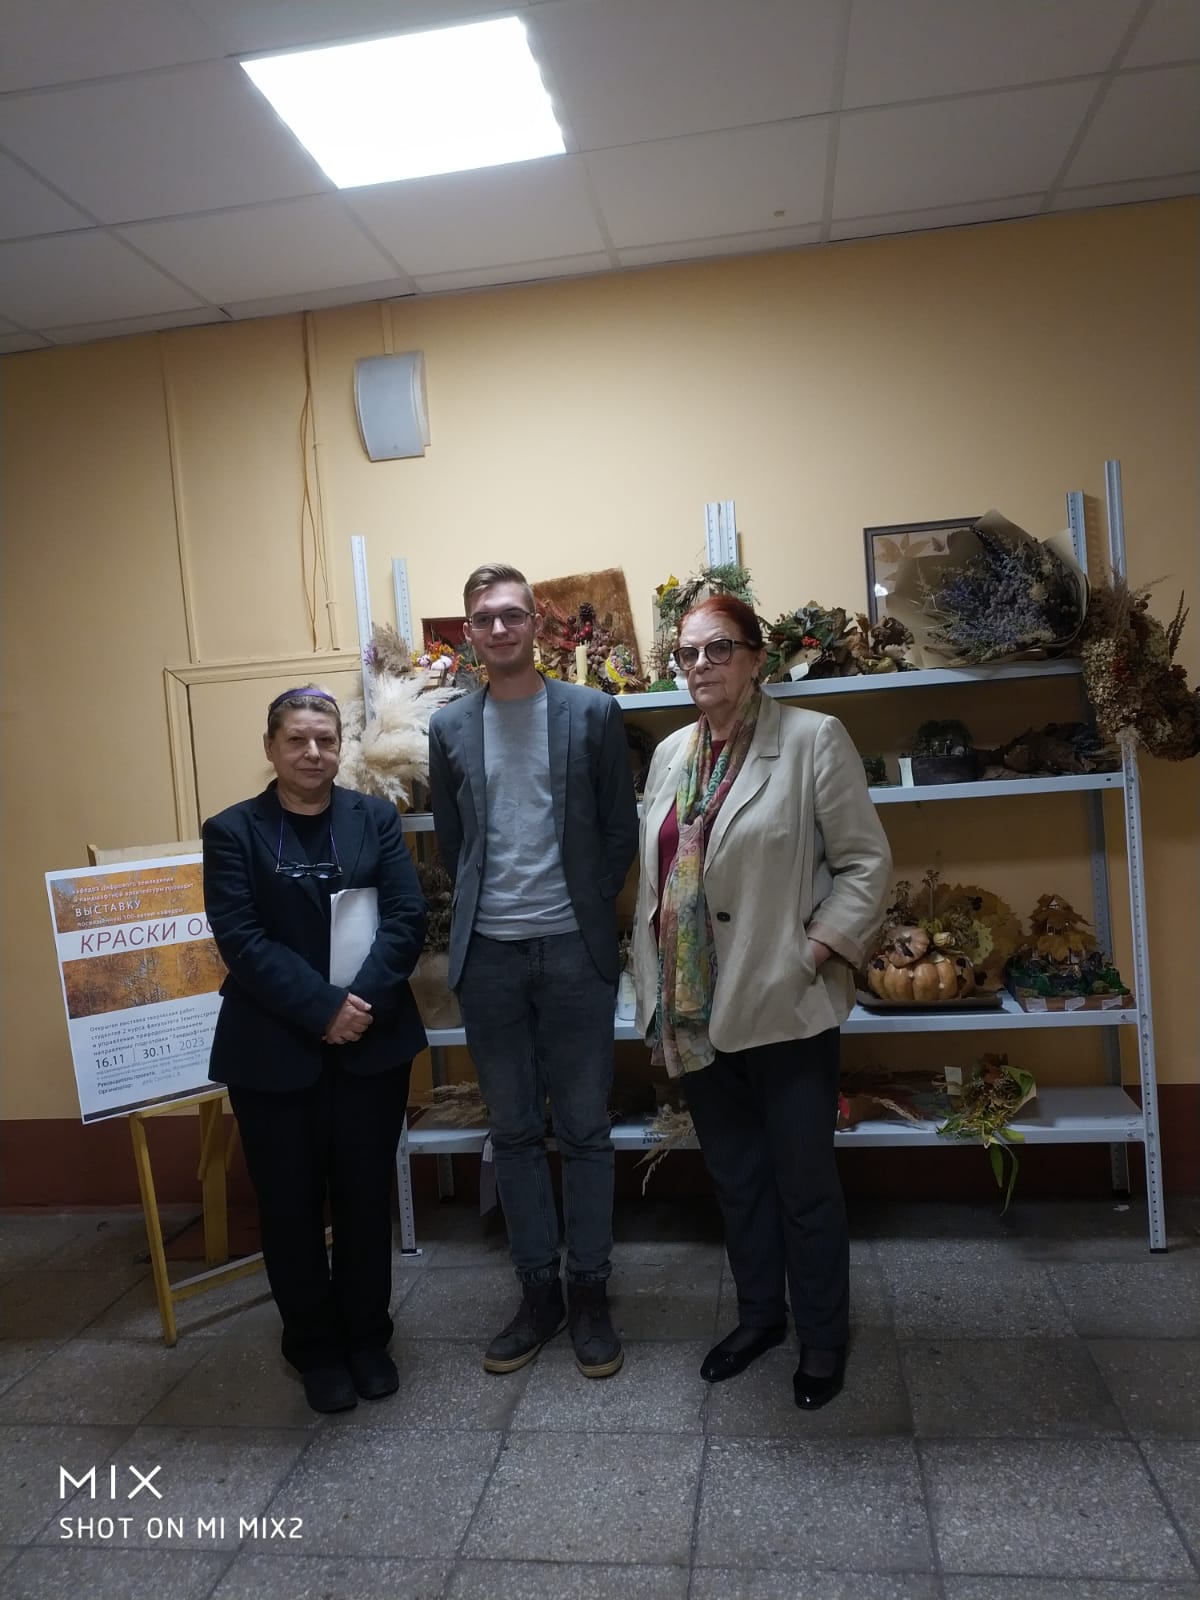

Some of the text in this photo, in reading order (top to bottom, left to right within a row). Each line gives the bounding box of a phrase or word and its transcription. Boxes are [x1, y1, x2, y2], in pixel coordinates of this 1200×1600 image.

[75, 899, 141, 917] ВЫСТАВКУ
[81, 921, 177, 954] КРАСКИ
[95, 1053, 124, 1069] 16.11
[143, 1044, 171, 1059] 30.11
[179, 1037, 205, 1051] 2023
